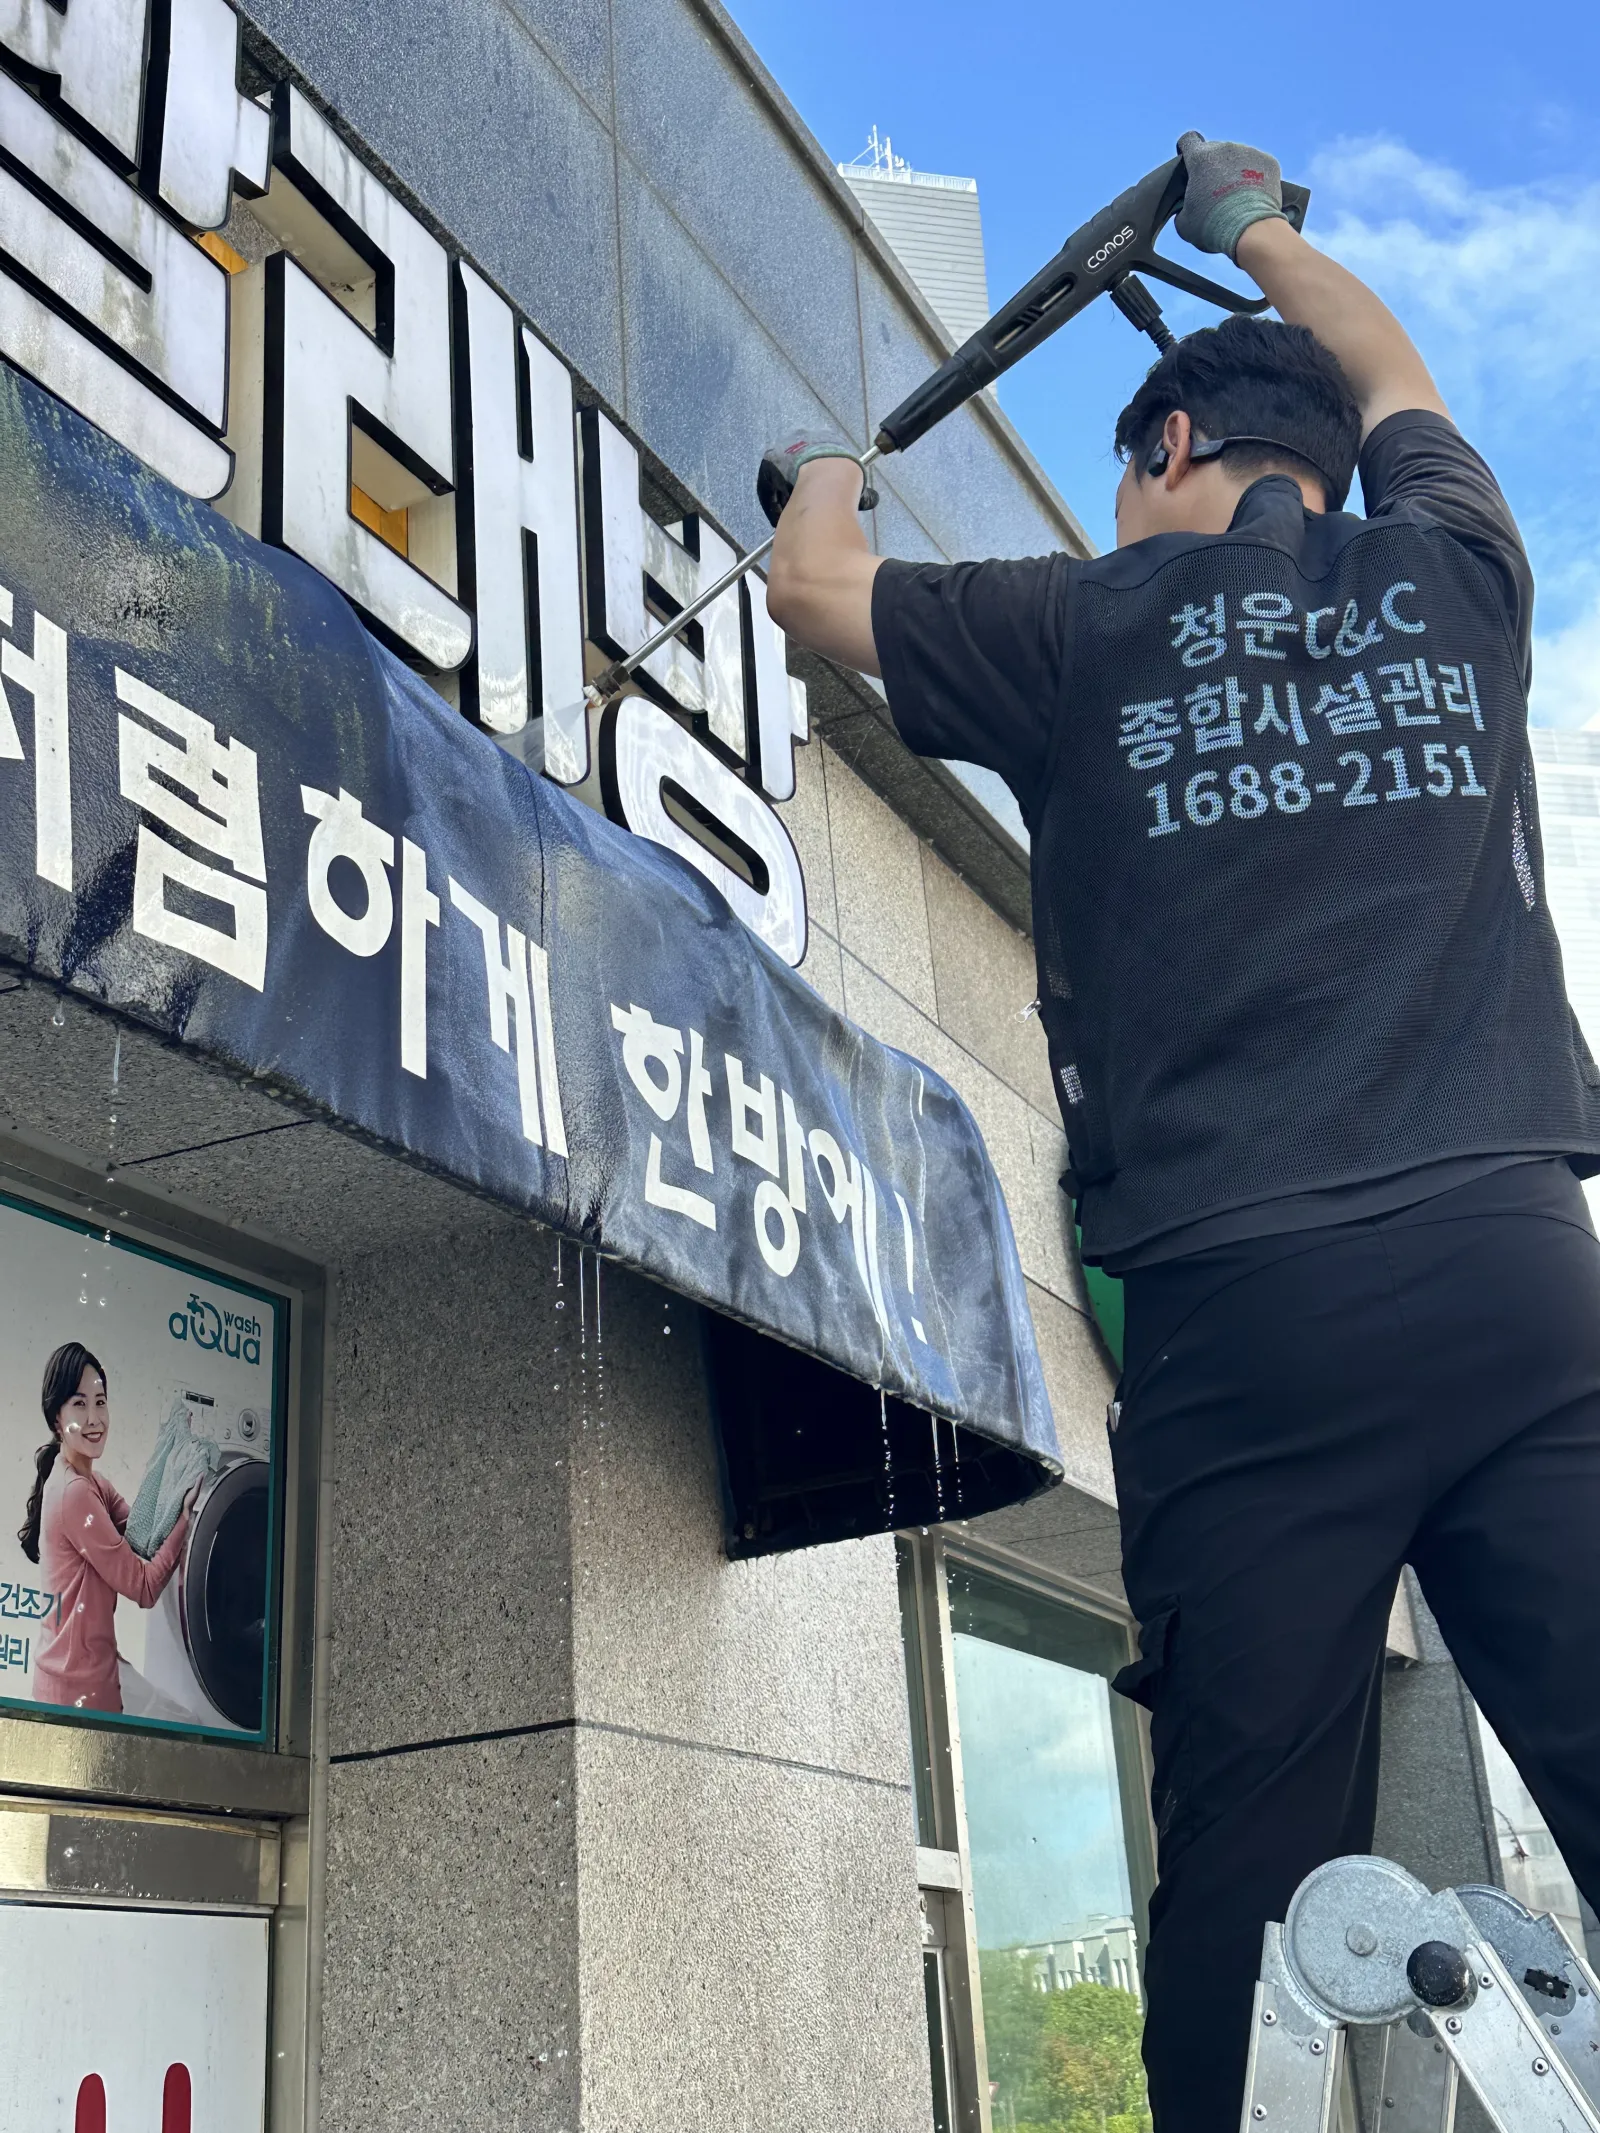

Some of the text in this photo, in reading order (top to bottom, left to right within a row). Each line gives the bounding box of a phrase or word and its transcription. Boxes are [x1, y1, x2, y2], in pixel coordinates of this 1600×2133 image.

[1241, 169, 1264, 181] 3M
[1147, 743, 1487, 837] 1688-2151
[223, 1310, 261, 1337] wash
[0, 1582, 63, 1627] 건조기
